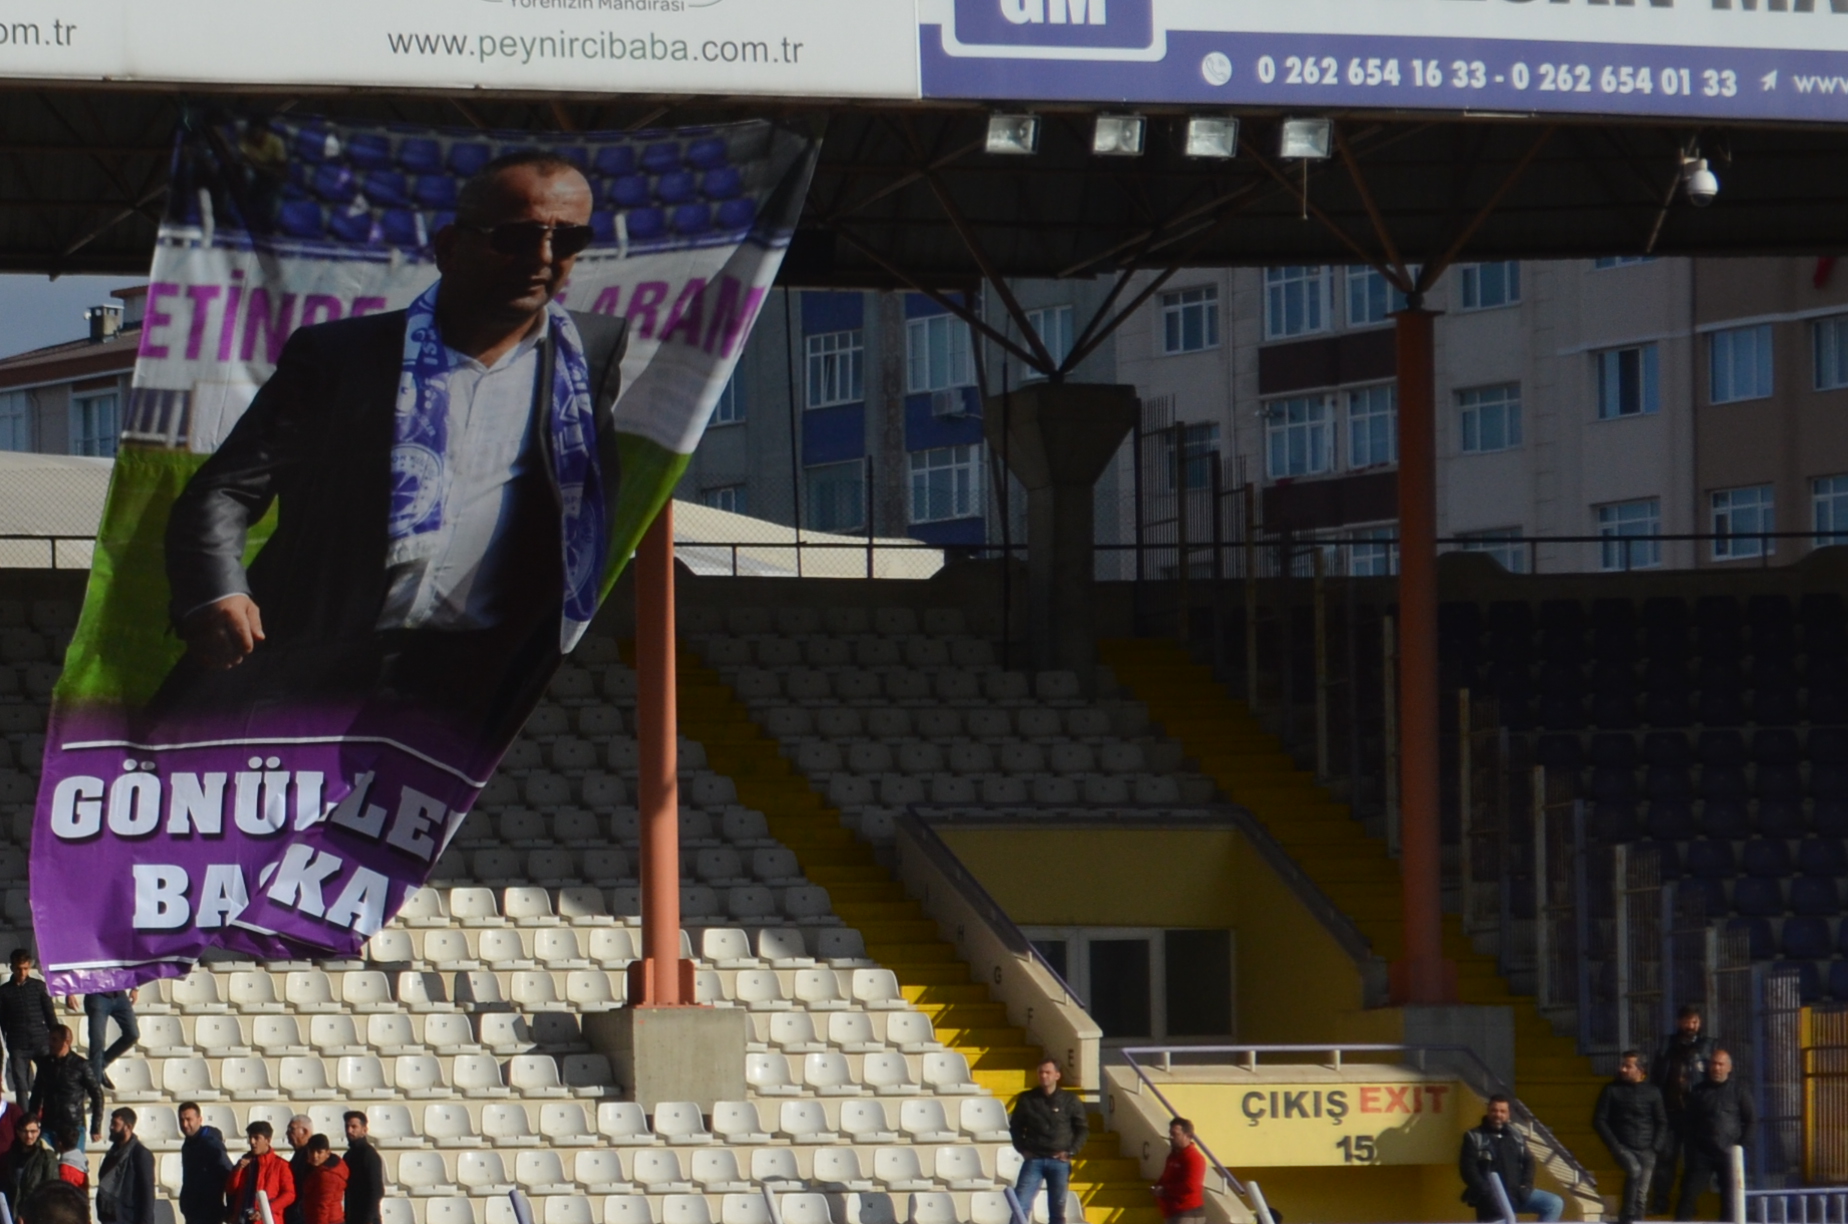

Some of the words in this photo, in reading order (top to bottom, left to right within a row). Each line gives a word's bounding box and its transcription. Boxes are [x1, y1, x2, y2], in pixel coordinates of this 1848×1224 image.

[387, 31, 805, 64] www.peynircibaba.com.tr
[1257, 55, 1276, 85] 0
[1285, 55, 1339, 85] 262
[1348, 57, 1401, 87] 654
[1412, 58, 1443, 88] 16
[1452, 60, 1487, 89] 33
[1512, 62, 1531, 90] 0
[1538, 64, 1592, 93] 262
[1601, 66, 1653, 95] 654
[1661, 68, 1692, 96] 01
[1703, 69, 1738, 98] 33
[132, 842, 390, 938] BAKA
[1241, 1090, 1350, 1127] ÇIKIŞ
[1359, 1086, 1450, 1114] EXIT
[1336, 1135, 1376, 1163] 15
